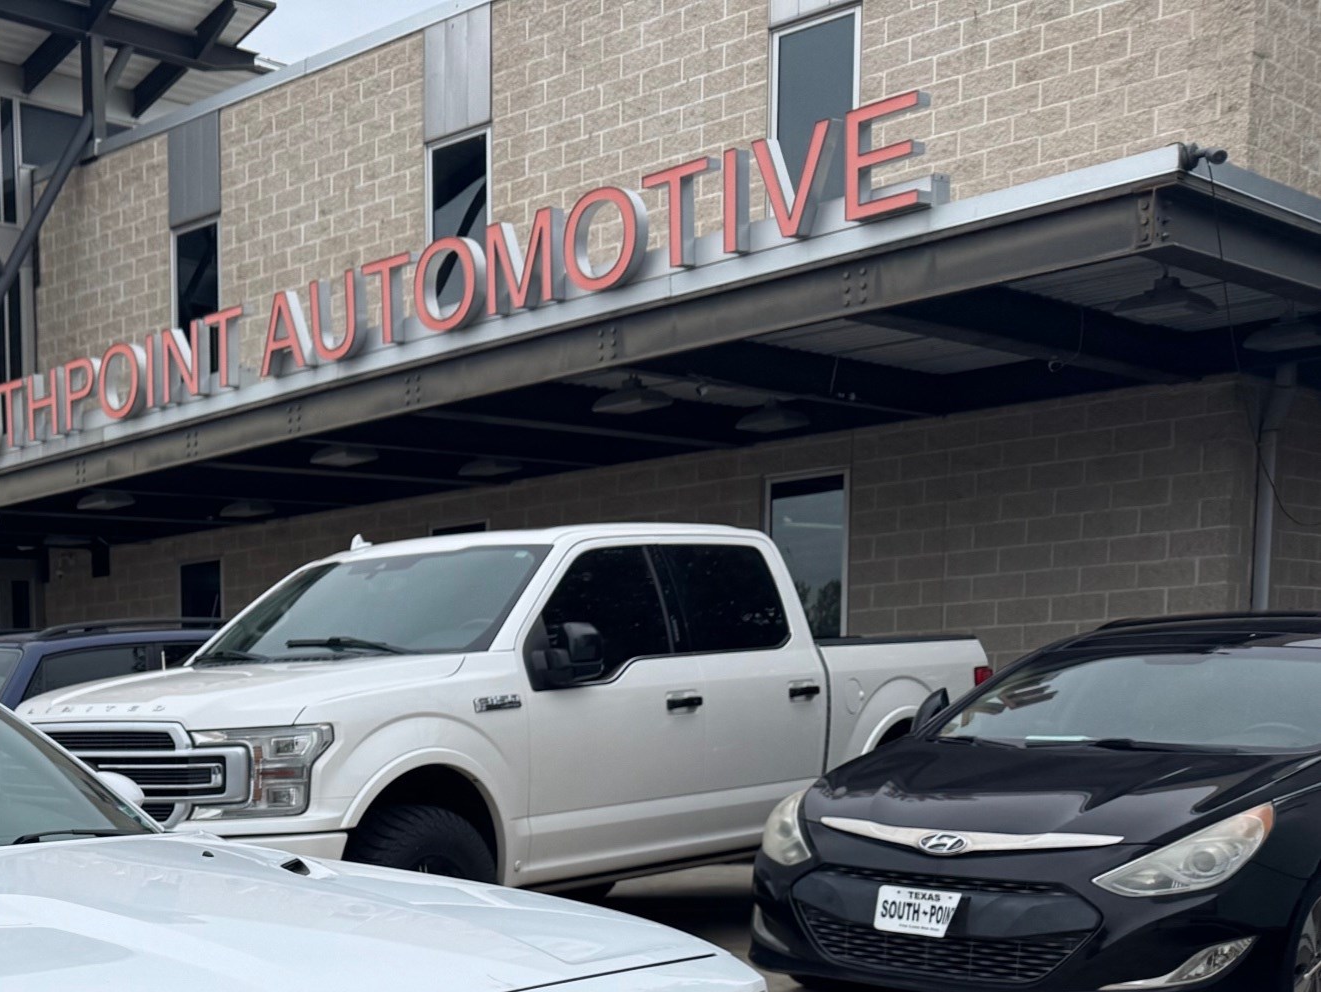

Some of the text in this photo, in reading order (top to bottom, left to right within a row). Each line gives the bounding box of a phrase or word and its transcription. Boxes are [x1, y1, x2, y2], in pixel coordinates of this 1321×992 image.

[260, 89, 920, 378] AUTOMOTIVE
[908, 891, 941, 901] TEXAS
[881, 900, 921, 922] SOUTH
